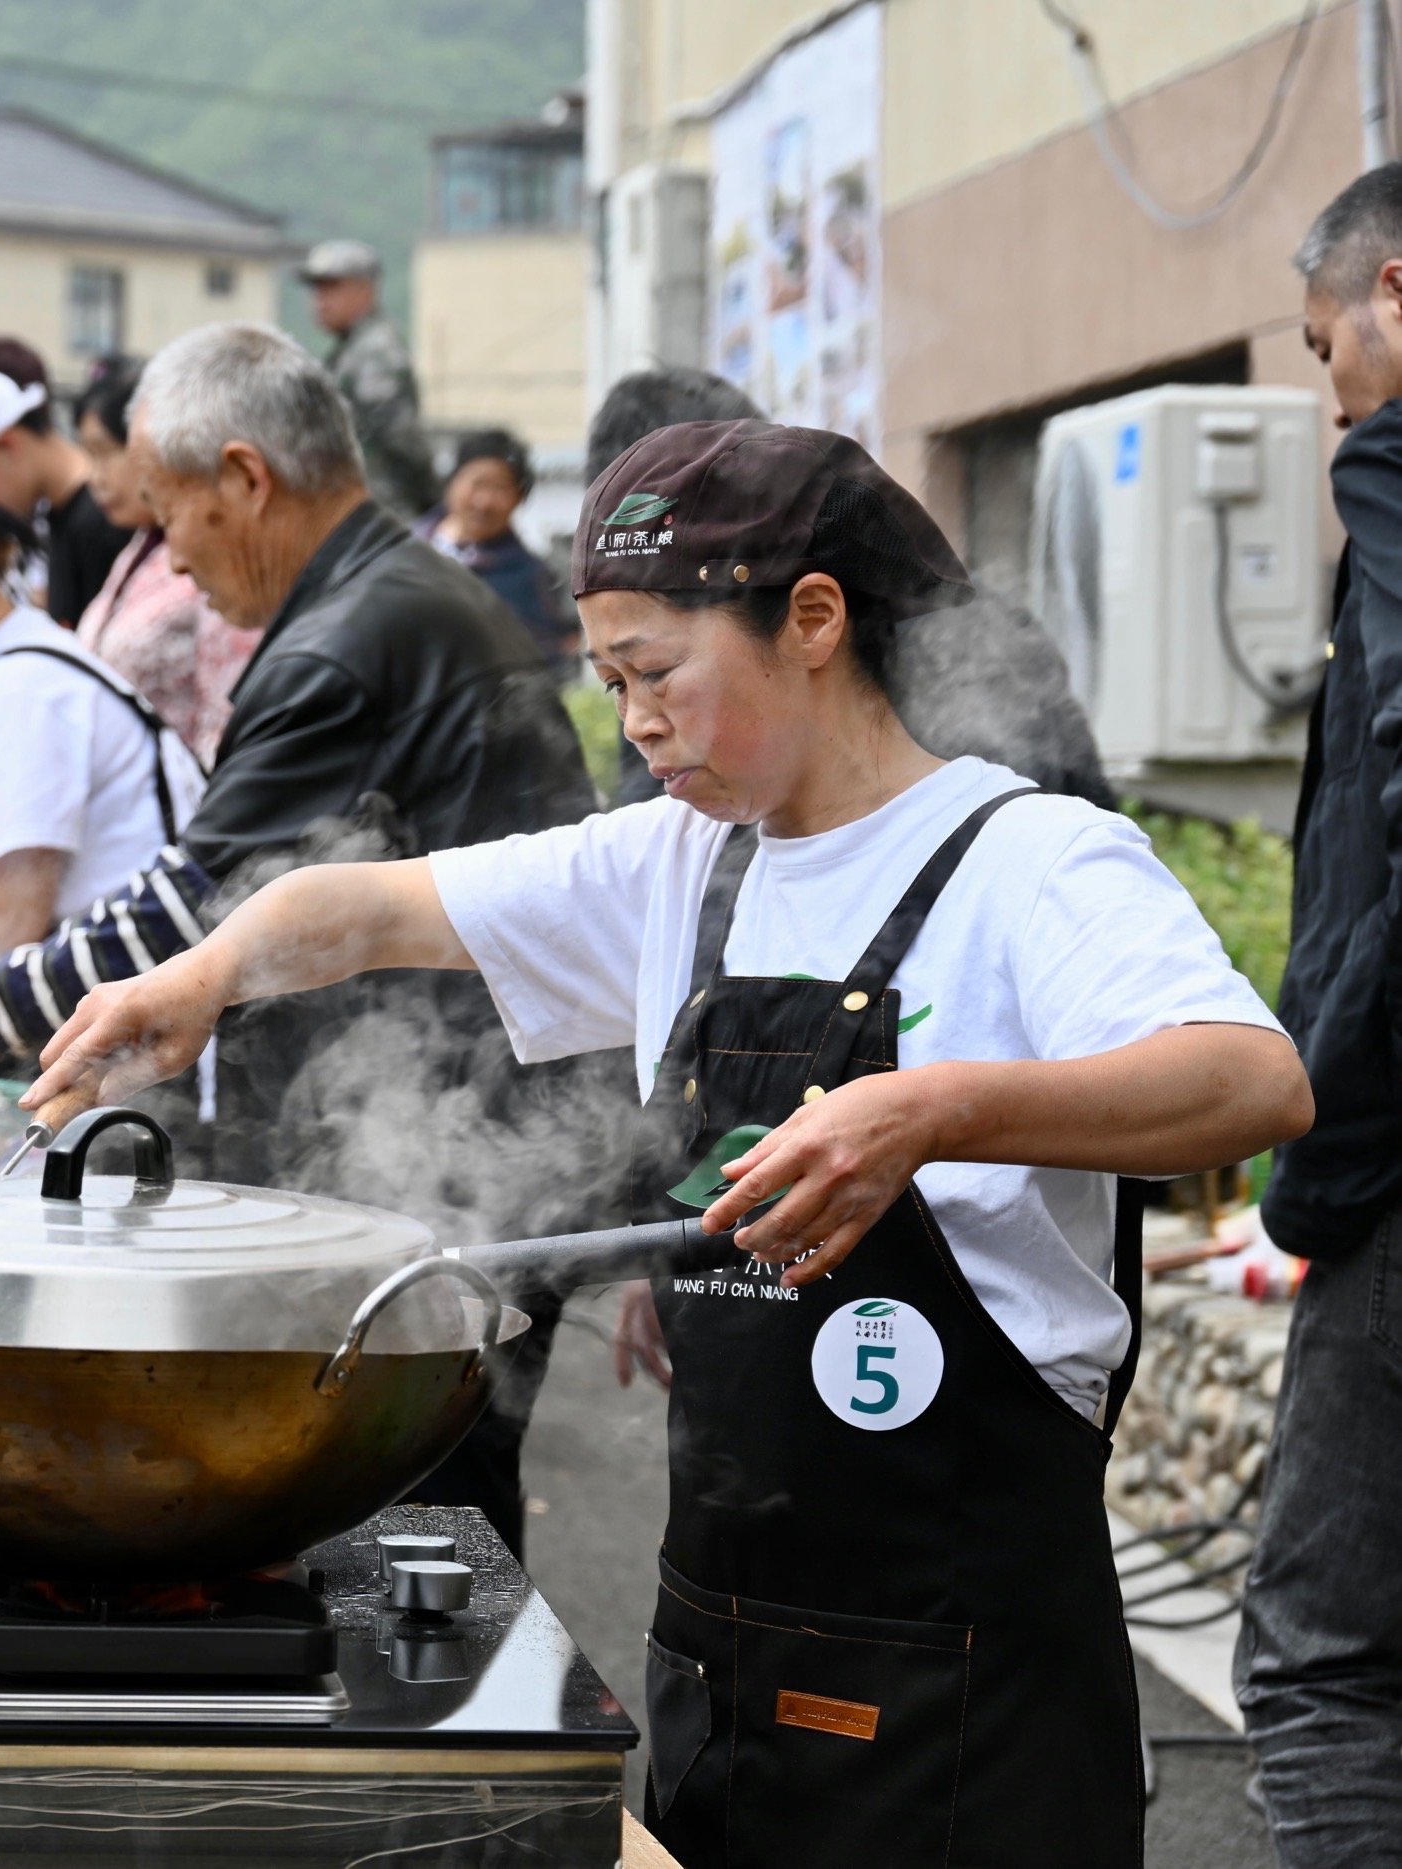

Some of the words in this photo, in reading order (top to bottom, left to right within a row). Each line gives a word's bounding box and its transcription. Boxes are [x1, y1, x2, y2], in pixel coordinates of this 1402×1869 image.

[605, 550, 619, 558] WANG
[642, 547, 660, 555] NIANG
[674, 1279, 705, 1294] WANG
[710, 1281, 727, 1296] FU
[731, 1282, 755, 1299] CHA
[760, 1285, 799, 1301] NIANG
[850, 1345, 900, 1415] 5
